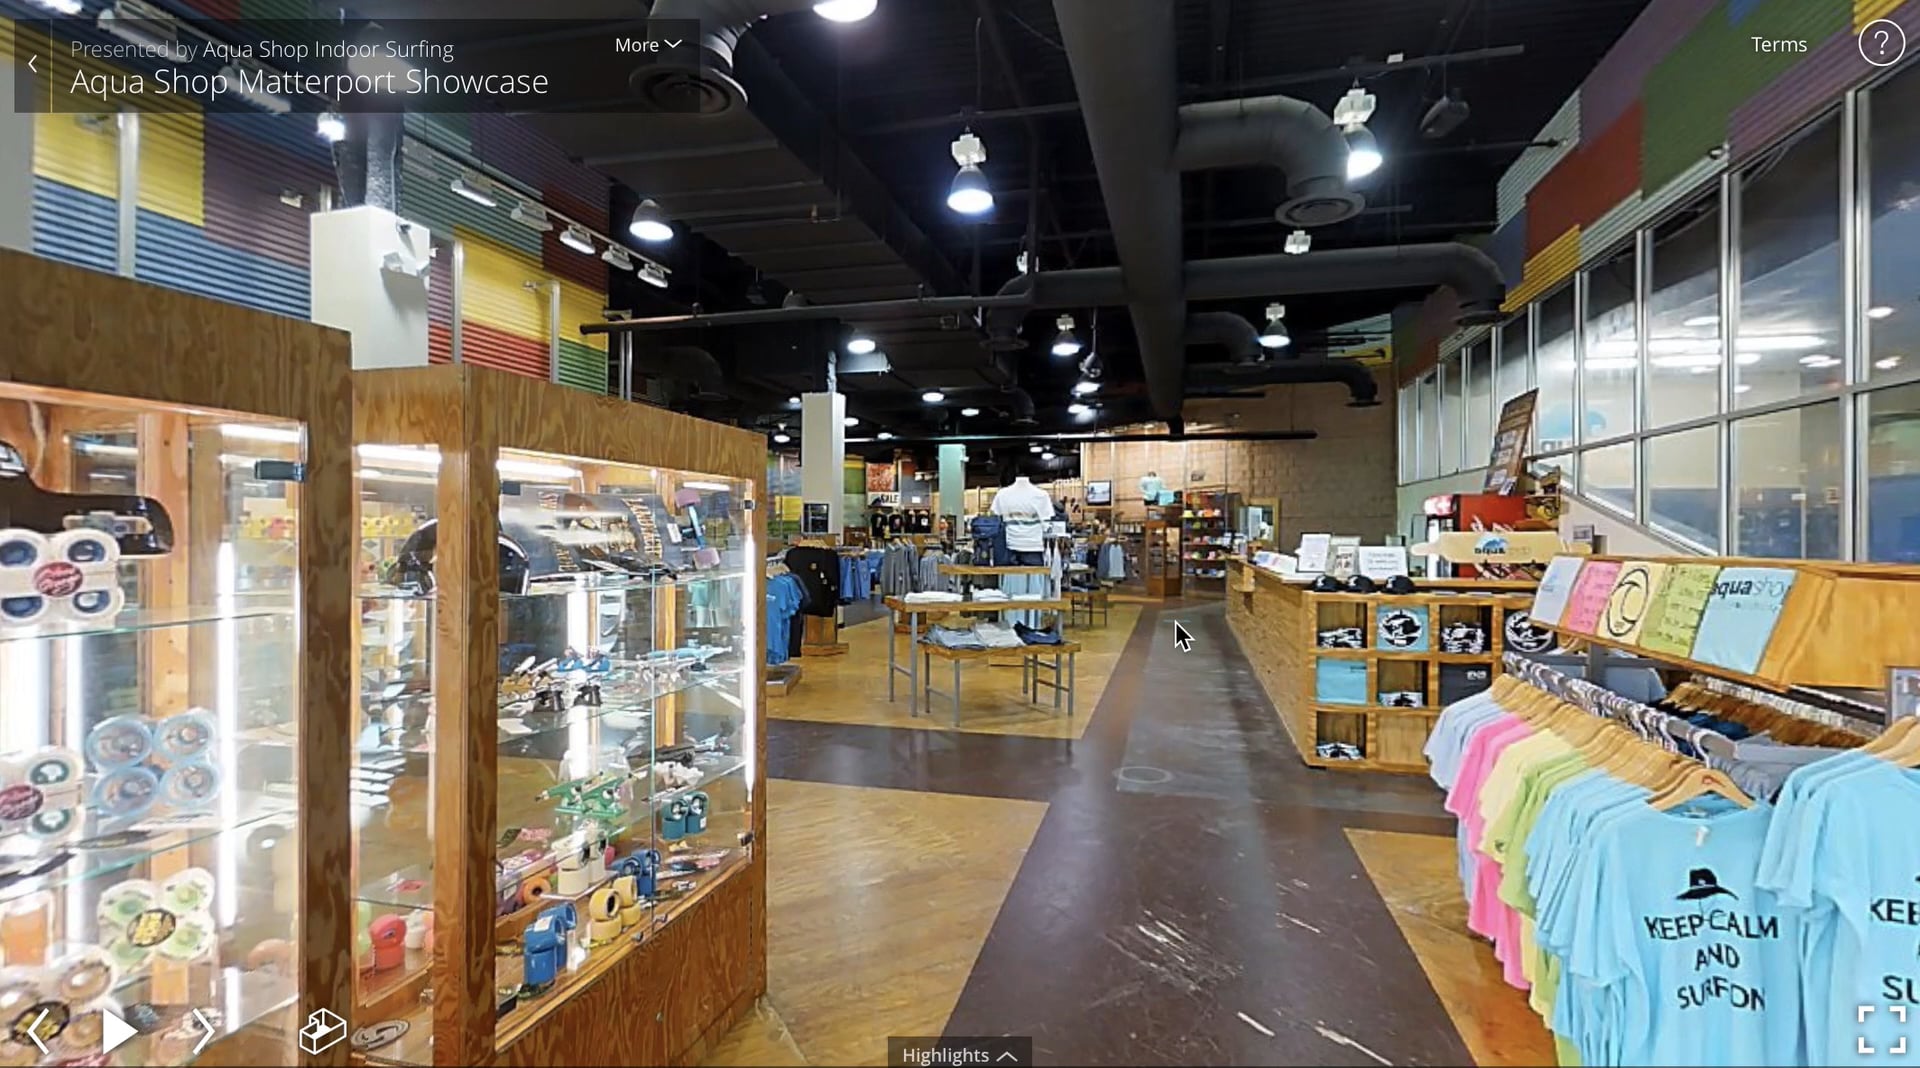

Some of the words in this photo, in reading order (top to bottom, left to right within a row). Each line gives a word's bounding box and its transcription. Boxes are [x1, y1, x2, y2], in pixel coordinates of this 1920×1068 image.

[1644, 914, 1704, 940] KEEP
[1710, 909, 1778, 939] CALM
[1695, 943, 1740, 971] AND
